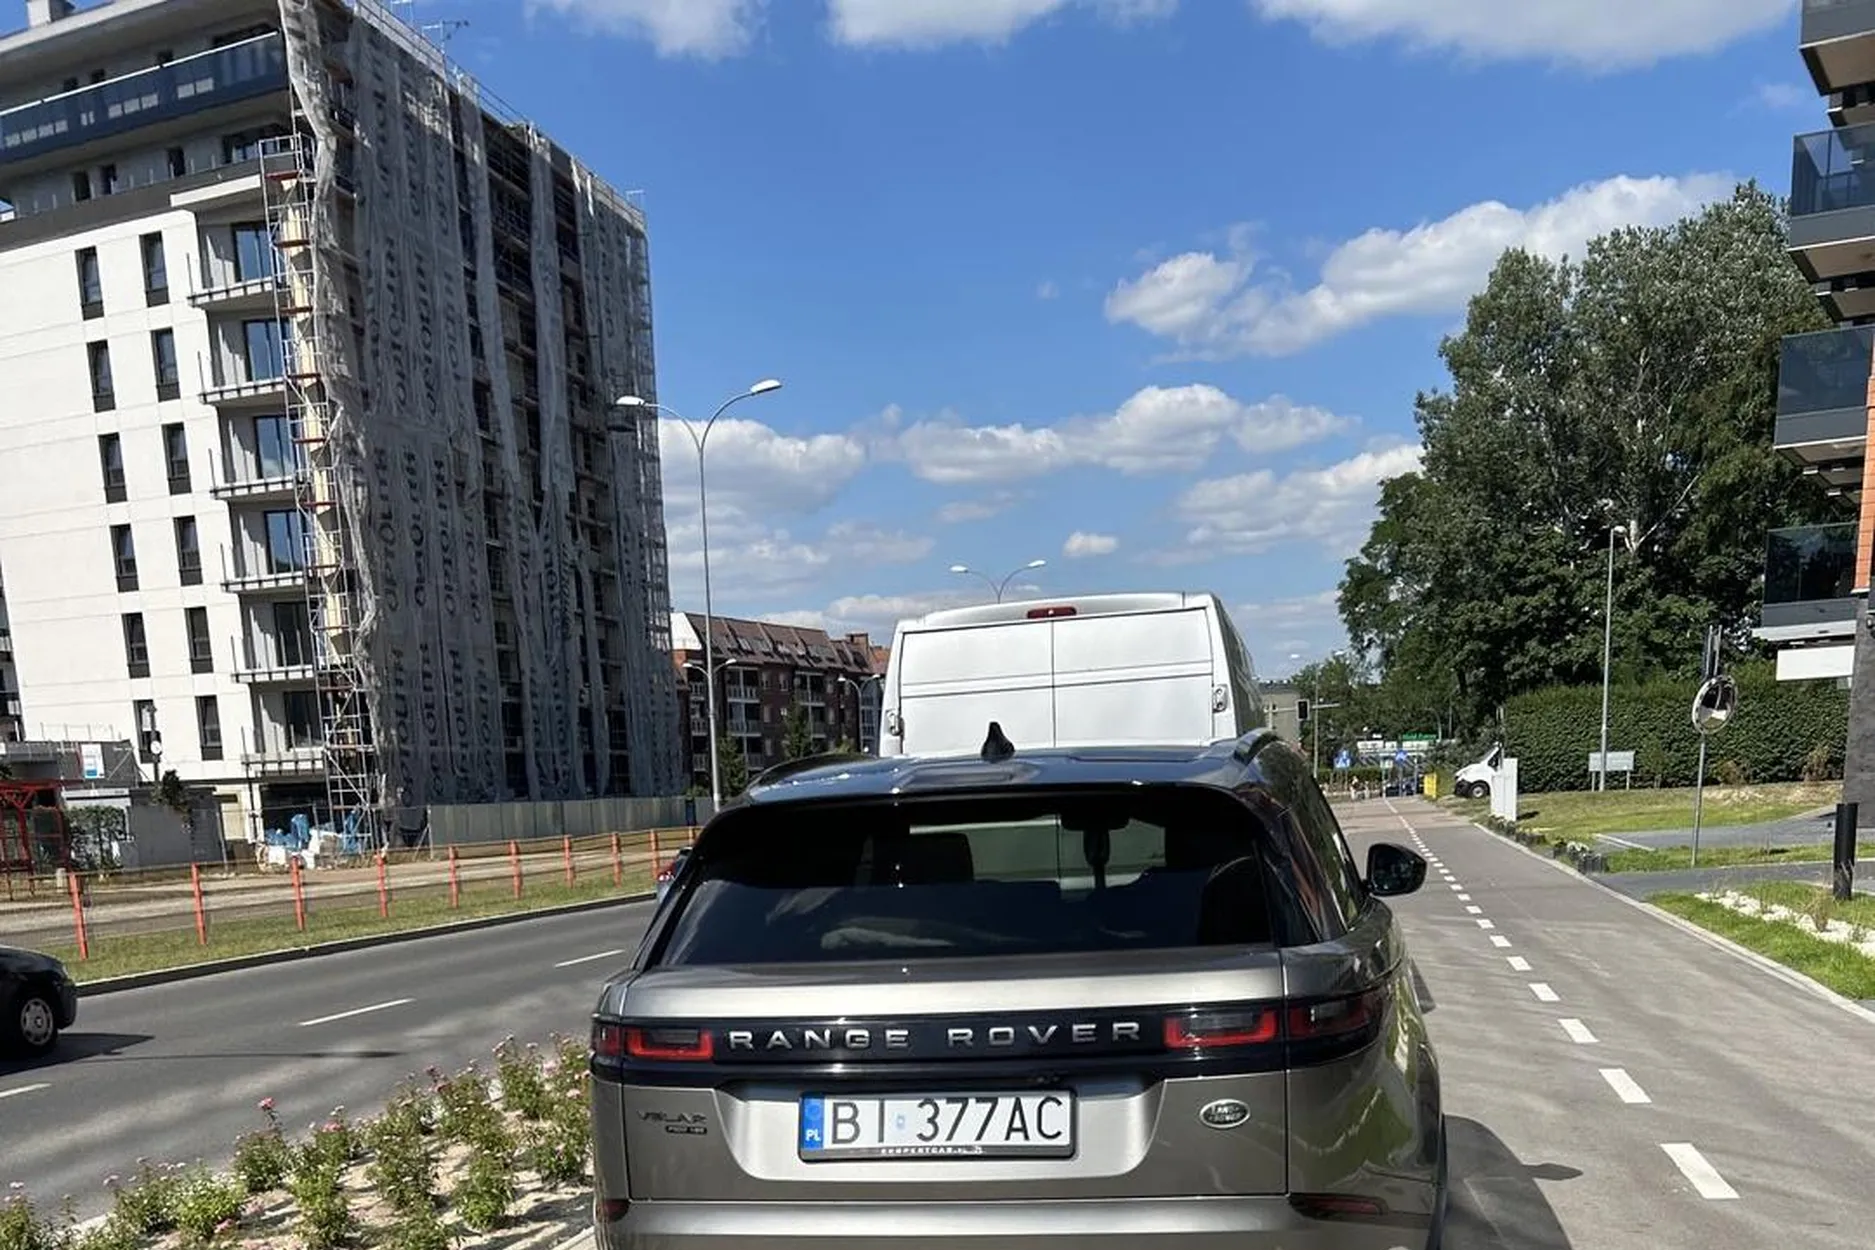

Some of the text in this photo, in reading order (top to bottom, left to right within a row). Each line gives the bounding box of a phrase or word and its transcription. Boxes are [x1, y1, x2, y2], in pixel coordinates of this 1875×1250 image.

[729, 1021, 1141, 1050] RANGE ROVER
[916, 1095, 1064, 1143] 377AC
[805, 1129, 821, 1142] PL
